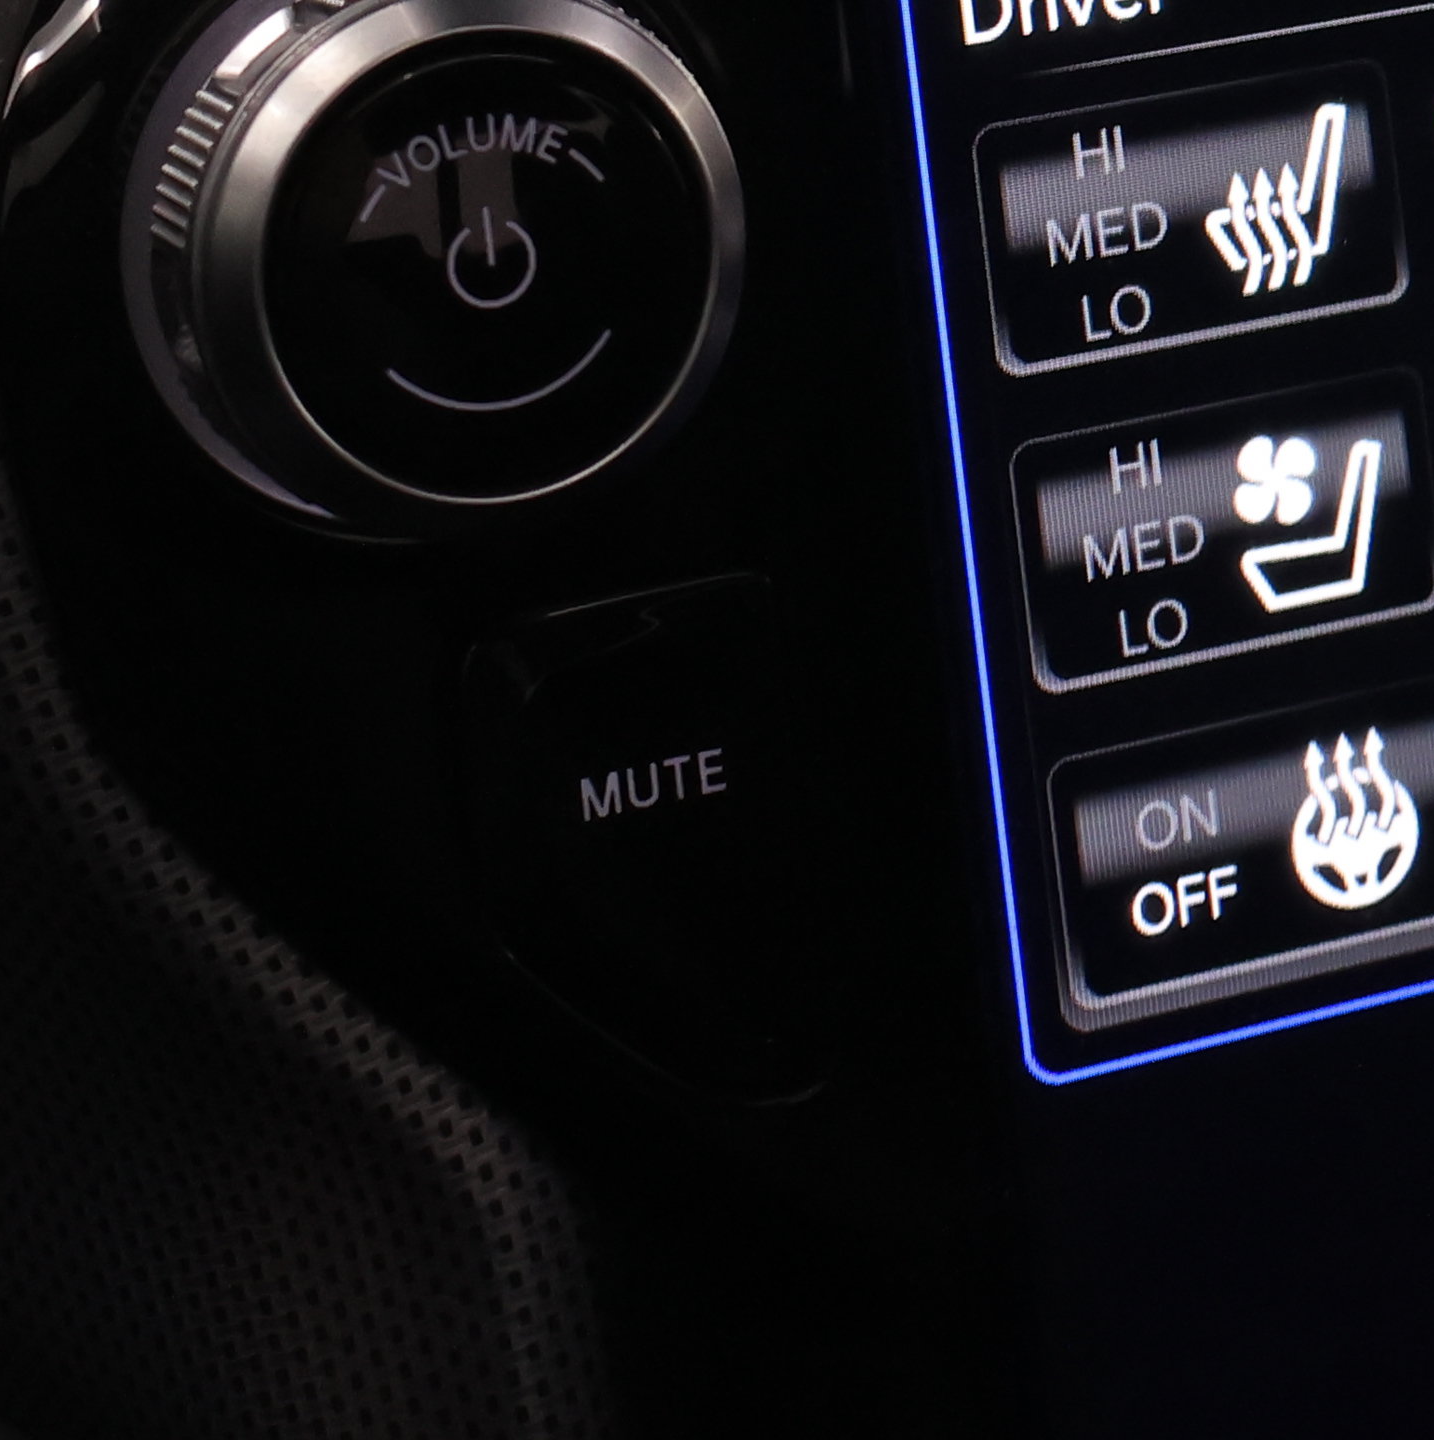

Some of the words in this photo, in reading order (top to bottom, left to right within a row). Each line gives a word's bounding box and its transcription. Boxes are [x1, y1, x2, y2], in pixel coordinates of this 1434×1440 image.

[378, 113, 569, 187] VOLUME
[1072, 125, 1126, 179] HI
[1046, 201, 1168, 267] MED
[1081, 284, 1152, 342] LO
[1110, 438, 1163, 495] HI
[1082, 516, 1205, 583] MED
[1118, 600, 1188, 658] LO
[580, 748, 727, 822] MUTE
[1135, 788, 1221, 852] ON
[1132, 864, 1239, 938] OFF
